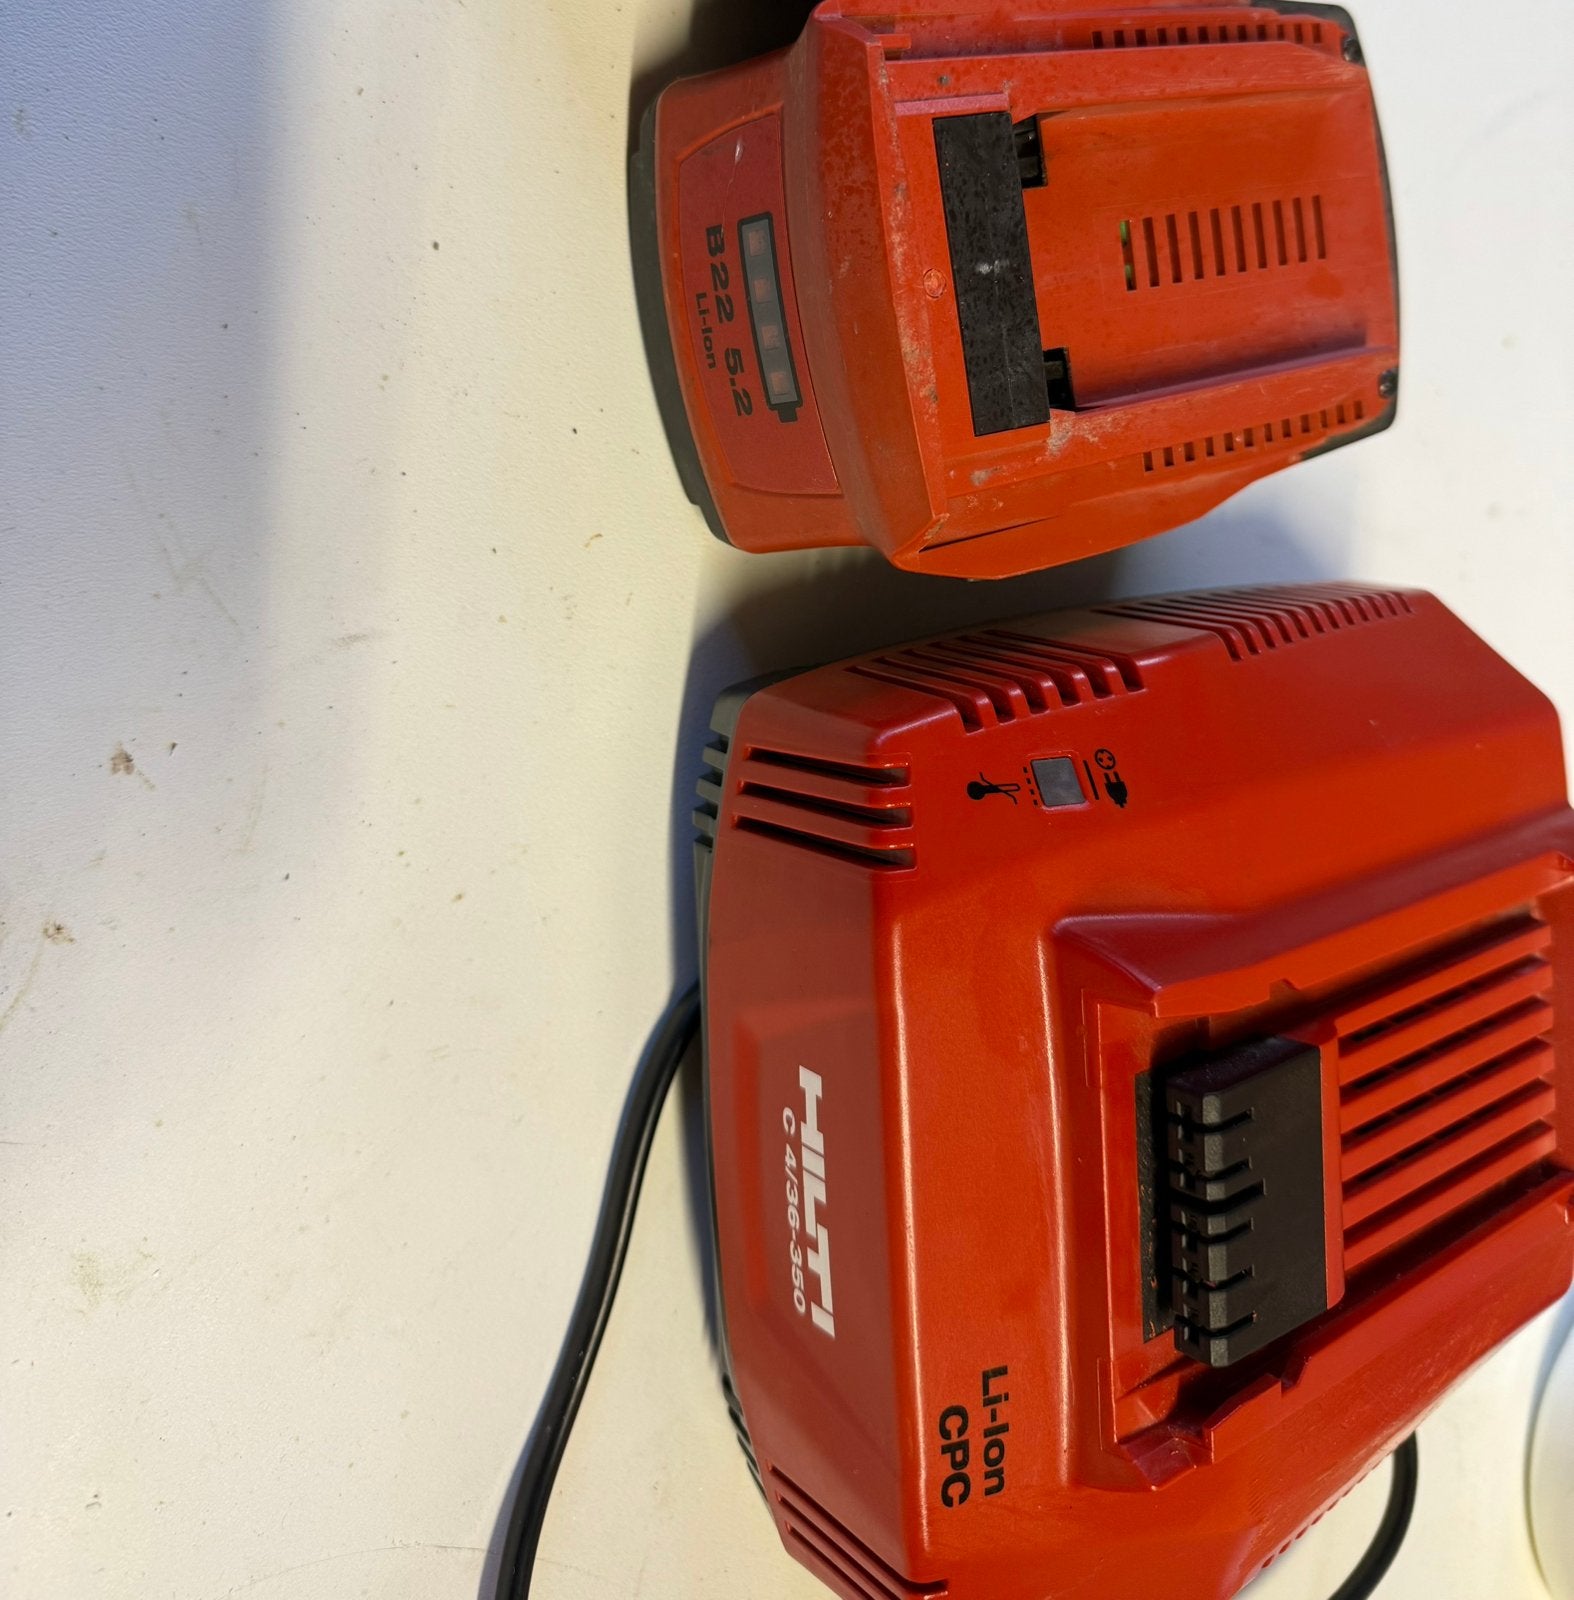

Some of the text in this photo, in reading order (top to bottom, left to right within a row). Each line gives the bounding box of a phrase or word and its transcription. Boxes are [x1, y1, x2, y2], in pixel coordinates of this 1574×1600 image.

[696, 292, 716, 369] Li-Ion
[725, 347, 753, 416] 5.2
[782, 1107, 806, 1317] C 4/36-350
[799, 1065, 836, 1339] HILTI
[939, 1405, 971, 1508] CPC
[982, 1365, 1010, 1497] Li-Ion
